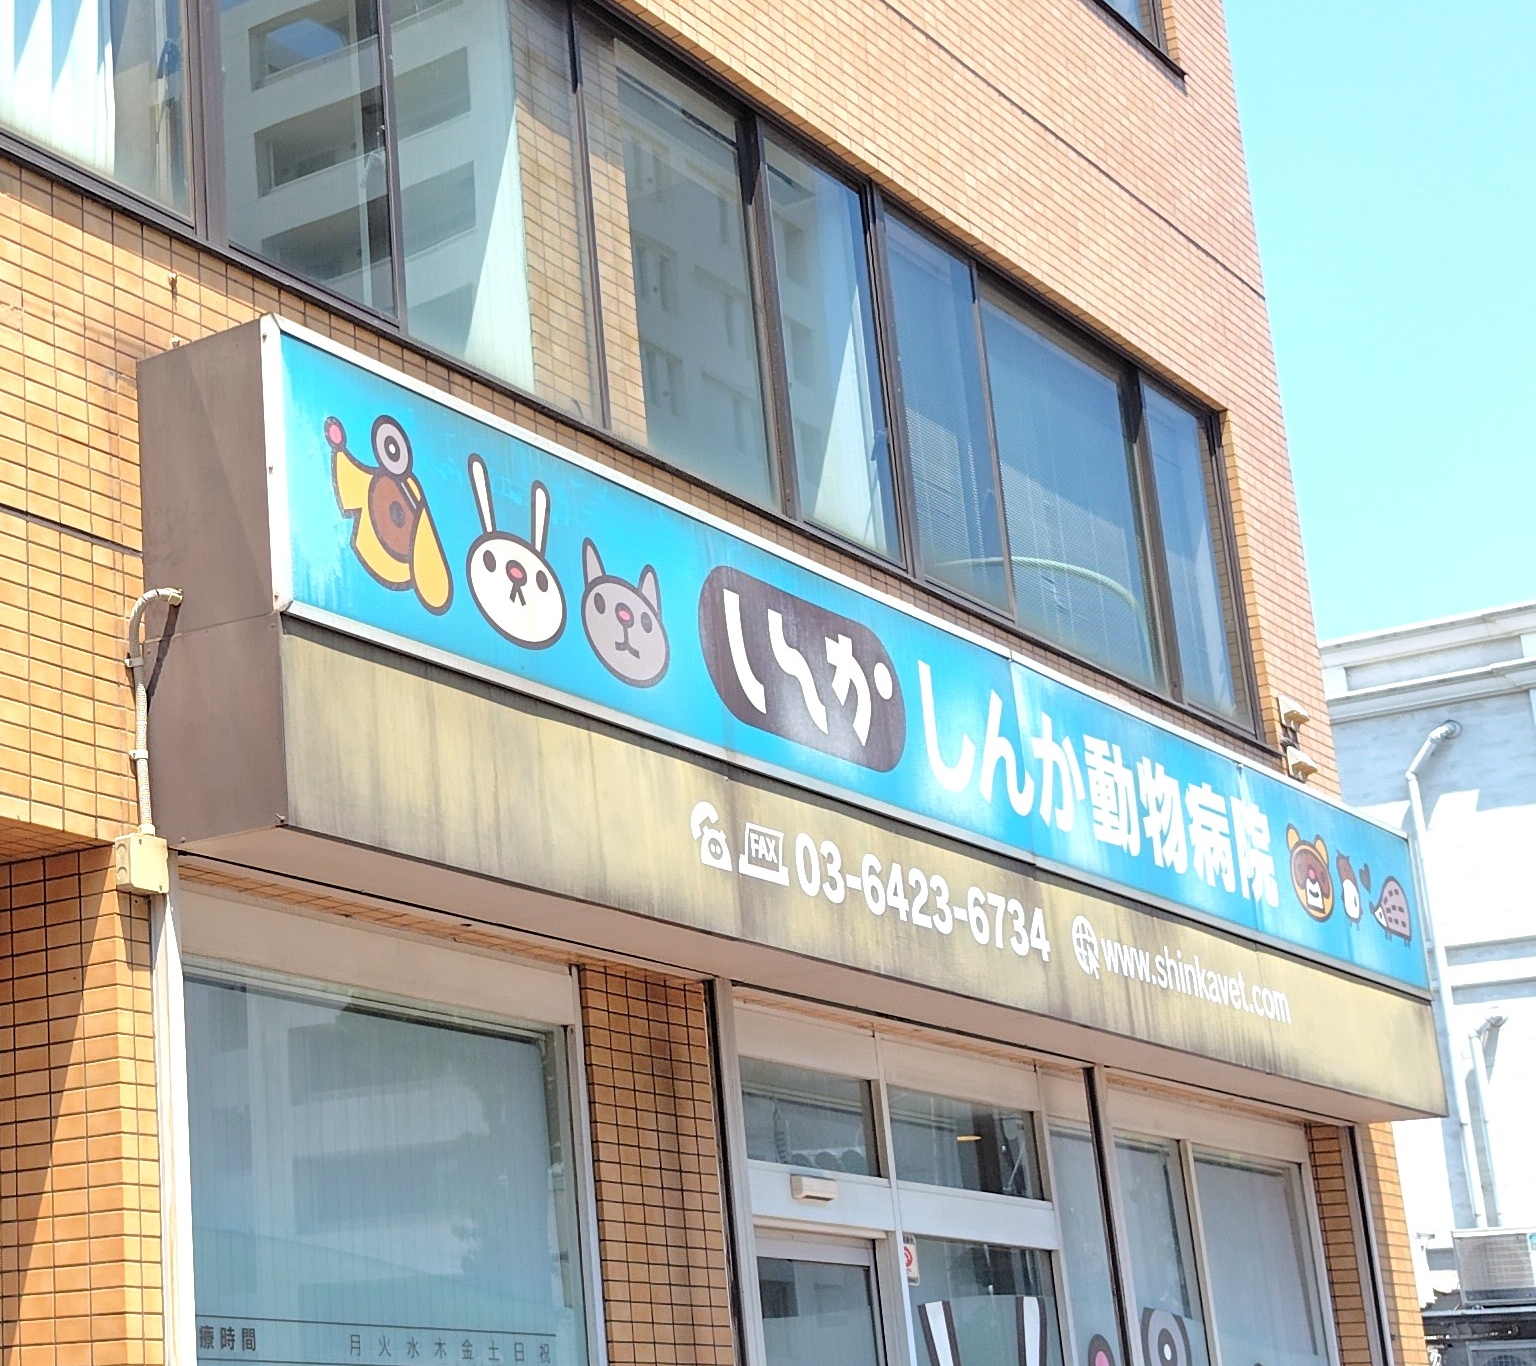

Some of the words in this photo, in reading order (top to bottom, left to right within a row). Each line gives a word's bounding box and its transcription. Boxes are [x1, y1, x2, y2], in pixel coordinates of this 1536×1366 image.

[917, 659, 1279, 908] しんか動物病院
[749, 831, 779, 864] FAX
[794, 831, 1050, 962] 03-6423-6734
[1100, 937, 1292, 1025] www.shinkavet.com
[350, 1334, 361, 1356] 月
[378, 1335, 392, 1357] 火
[407, 1336, 420, 1359] 水
[434, 1337, 447, 1359] 木
[461, 1339, 474, 1360] 金
[488, 1340, 500, 1361] 土
[514, 1341, 525, 1362] 日
[539, 1342, 551, 1364] 祝
